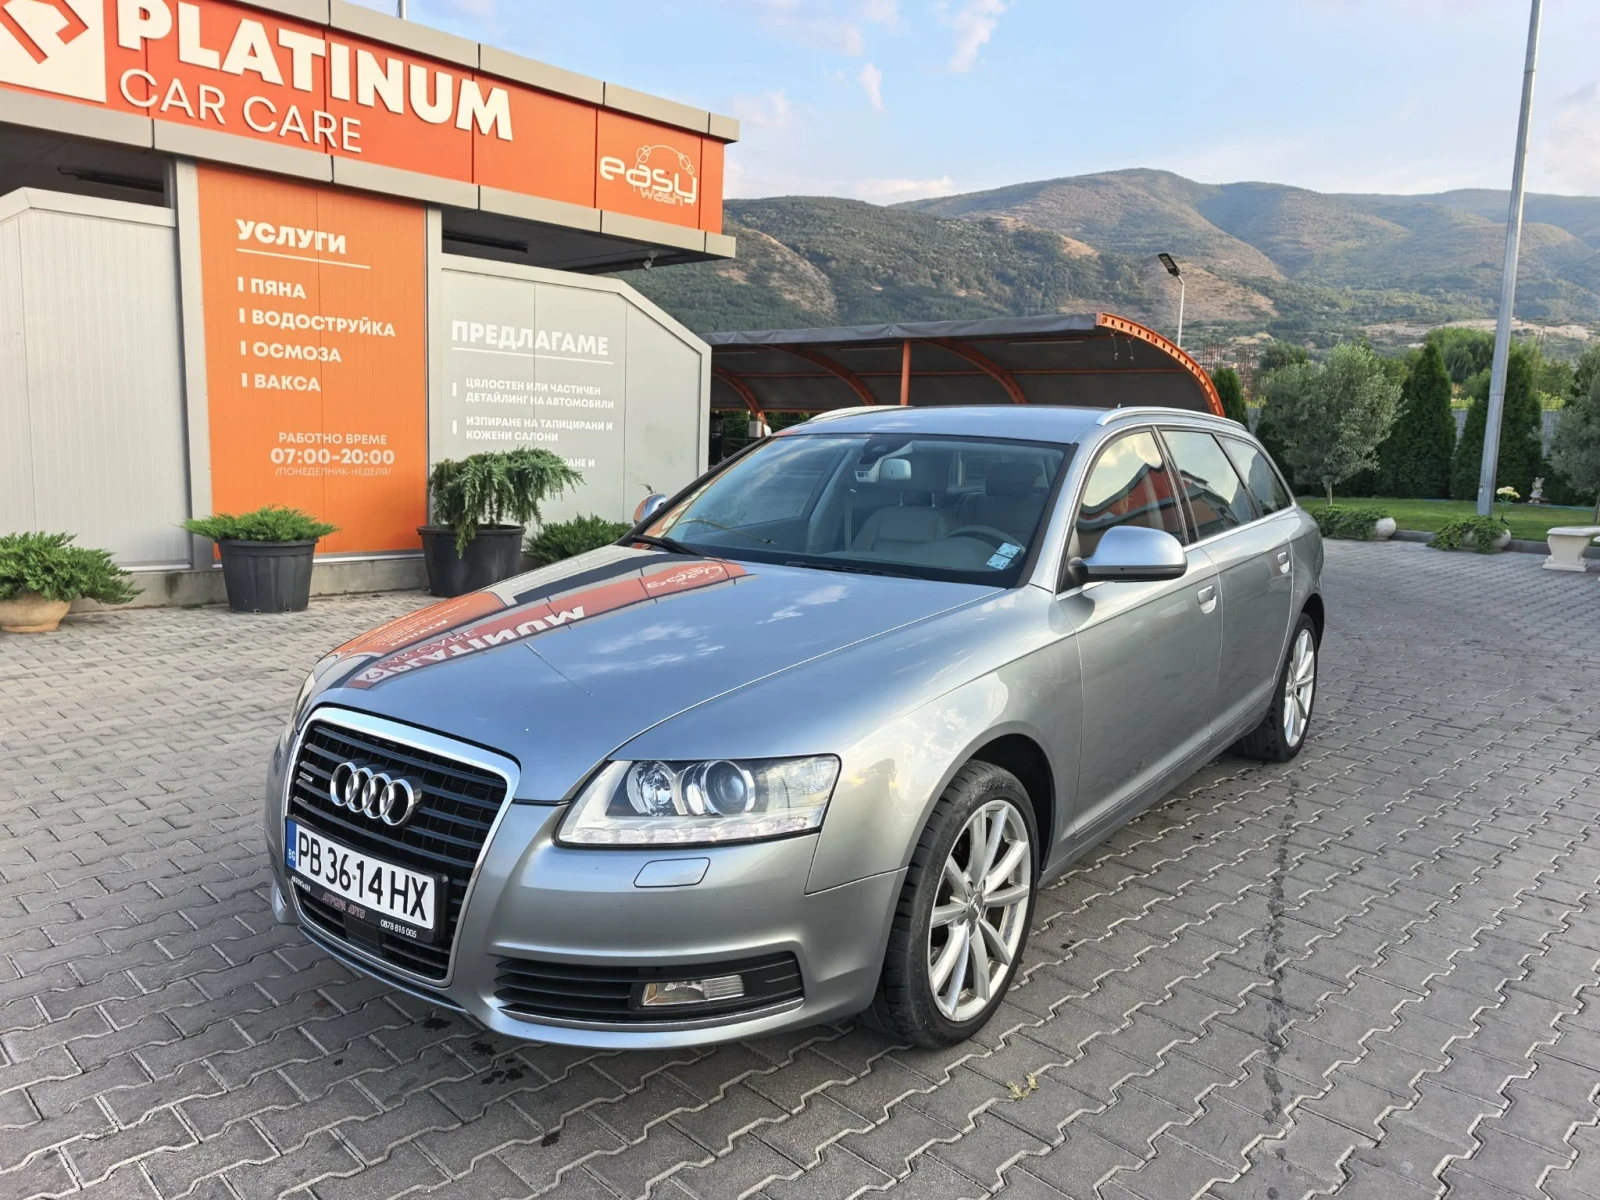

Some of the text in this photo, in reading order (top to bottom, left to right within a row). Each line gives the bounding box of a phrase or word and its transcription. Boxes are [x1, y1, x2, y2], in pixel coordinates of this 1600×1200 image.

[117, 0, 513, 141] PLATINUM
[120, 68, 362, 153] CAR CARE
[600, 156, 698, 204] easy
[235, 218, 346, 255] УСЛУГИ
[250, 277, 307, 299] ПЯНА
[251, 309, 396, 337] ВОДОСТРУЙКА
[451, 320, 609, 356] ПРЕДЛАГАМЕ
[252, 341, 342, 363] ОСМОЗА
[254, 374, 321, 392] ВАКСА
[465, 377, 601, 396] ЦЯЛОСТЕН ИЛИ ЧАСТИЧЕН
[465, 391, 614, 409] ДЕТАЙЛИНГ НА АВТОМОБИЛИ
[466, 415, 613, 431] ИЗПИРАНЕ НА ТАПИЦИРАНИ И
[278, 431, 387, 445] РАБОТНО ВРЕМЕ
[466, 430, 558, 442] КОЖЕНИ САЛОНИ
[270, 447, 395, 465] 07:00-20:00
[588, 458, 595, 468] И
[288, 848, 296, 861] BG
[298, 831, 428, 922] PB 3614 HX
